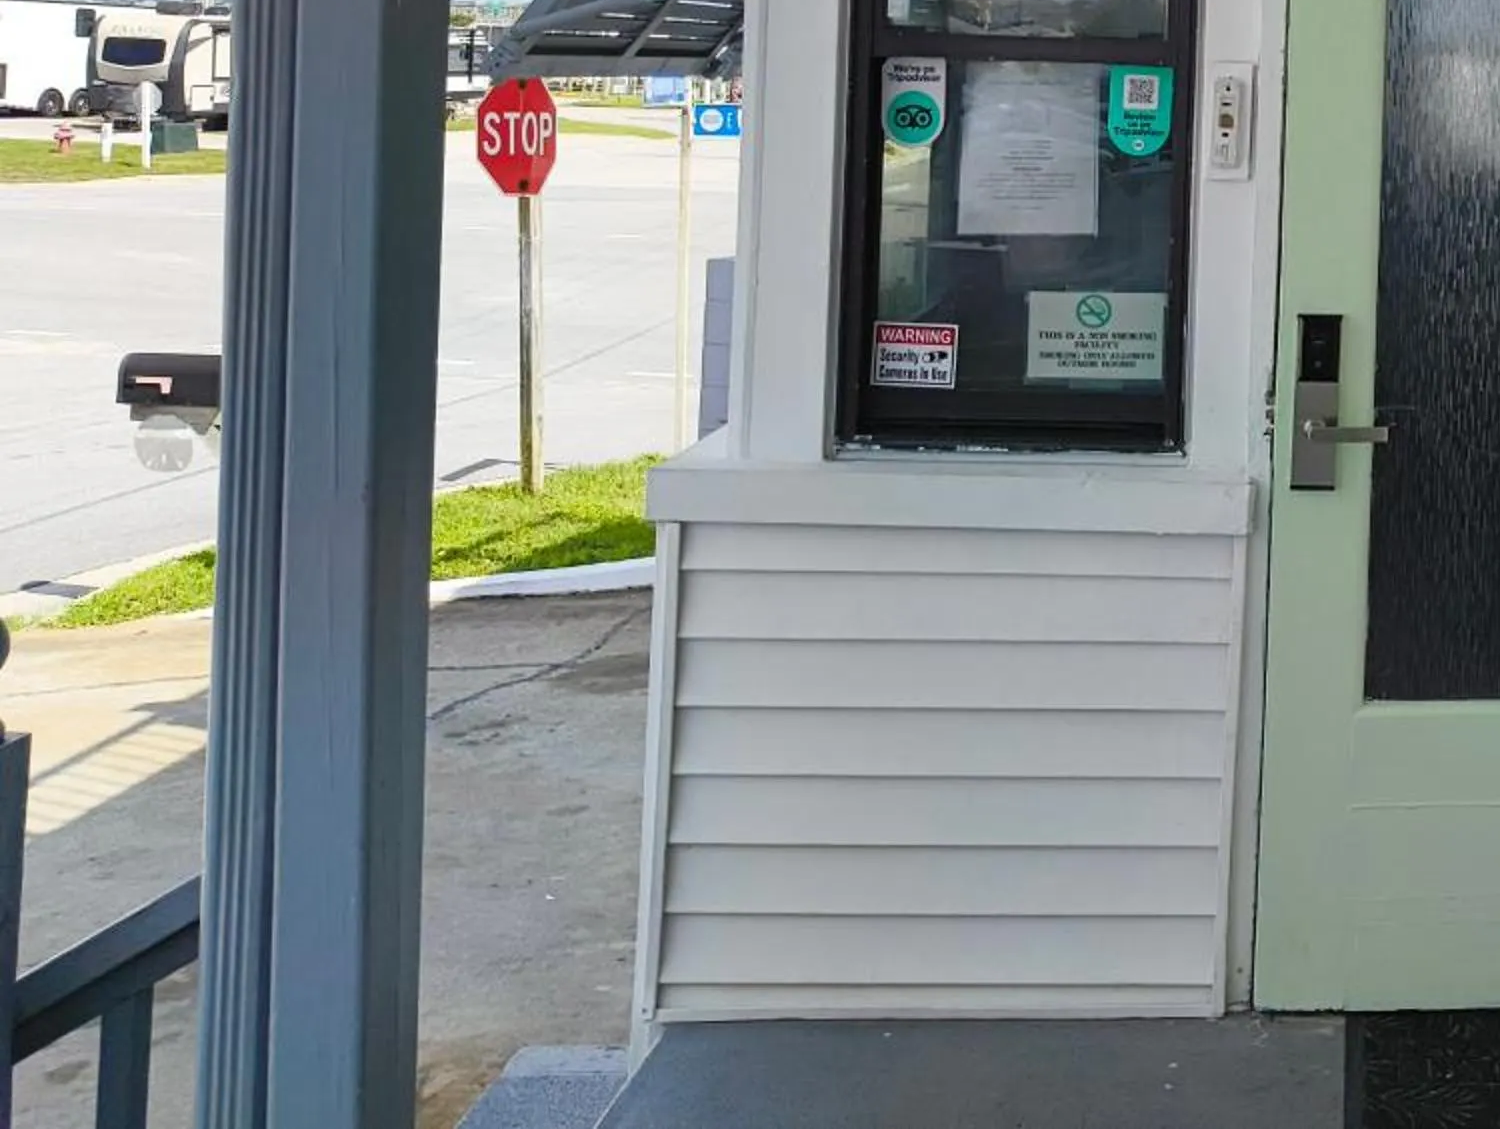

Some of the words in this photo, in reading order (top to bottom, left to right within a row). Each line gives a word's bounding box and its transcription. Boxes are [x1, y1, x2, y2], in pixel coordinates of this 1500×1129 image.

[483, 111, 553, 156] STOP
[880, 327, 952, 344] WARNING
[880, 347, 919, 366] Security
[879, 364, 918, 380] Cameras
[932, 367, 948, 381] Use
